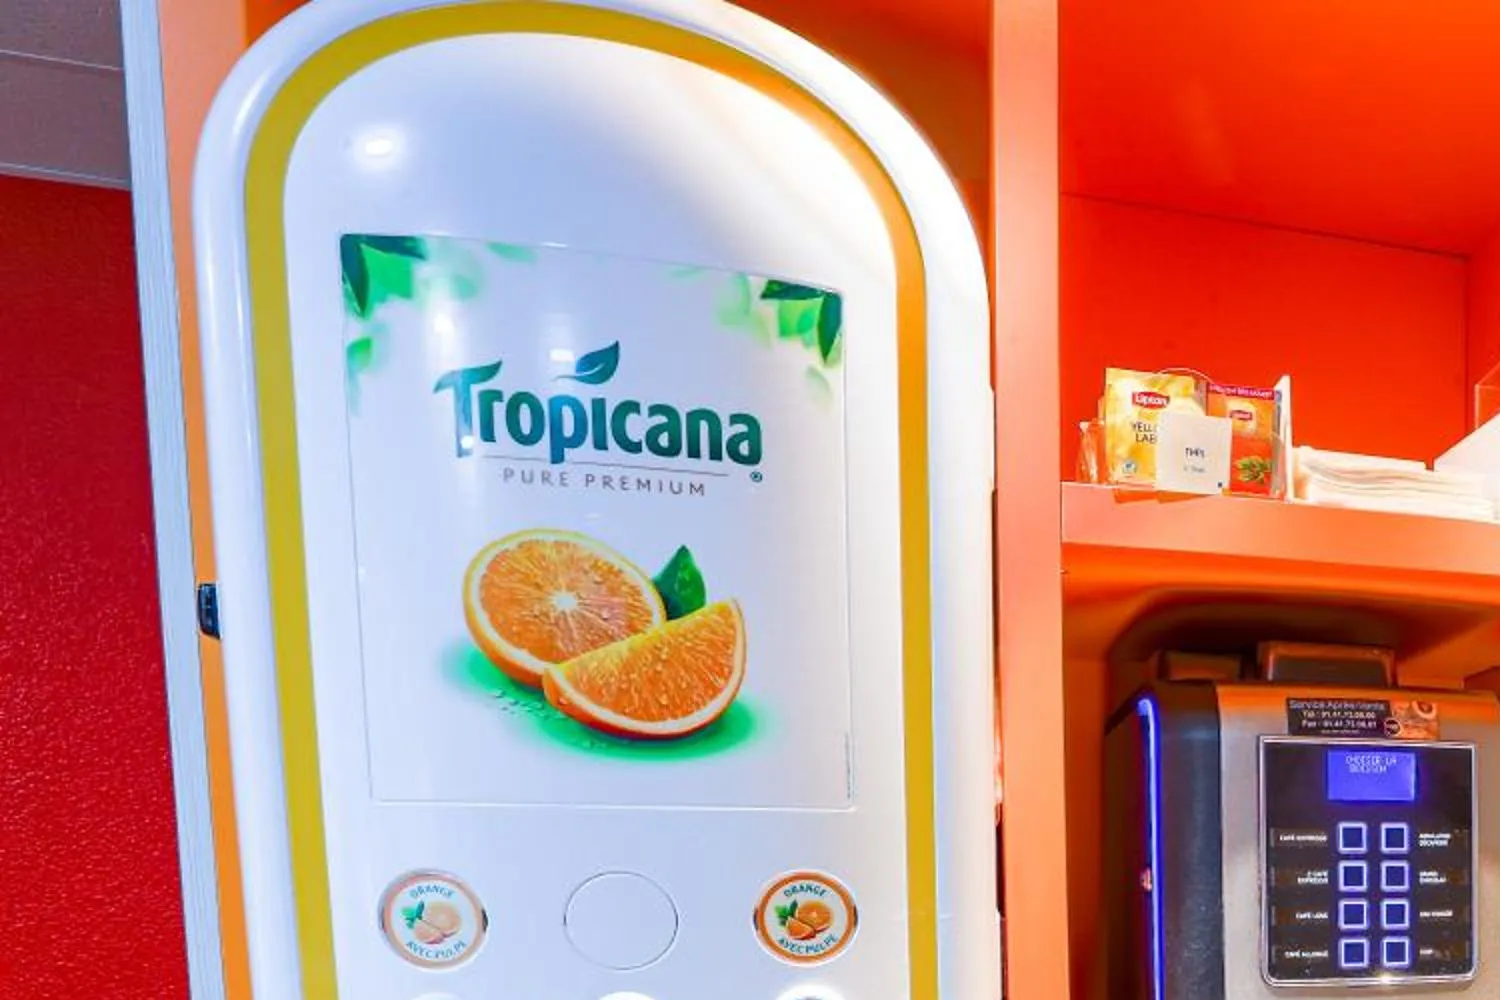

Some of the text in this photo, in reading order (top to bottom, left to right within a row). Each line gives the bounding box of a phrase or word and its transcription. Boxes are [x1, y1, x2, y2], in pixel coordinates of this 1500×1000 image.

[433, 359, 763, 466] Tropicana
[1131, 420, 1157, 433] YELL
[1136, 433, 1157, 444] LAB
[502, 466, 705, 496] PURE PREMIUM
[783, 884, 827, 898] ORANGE
